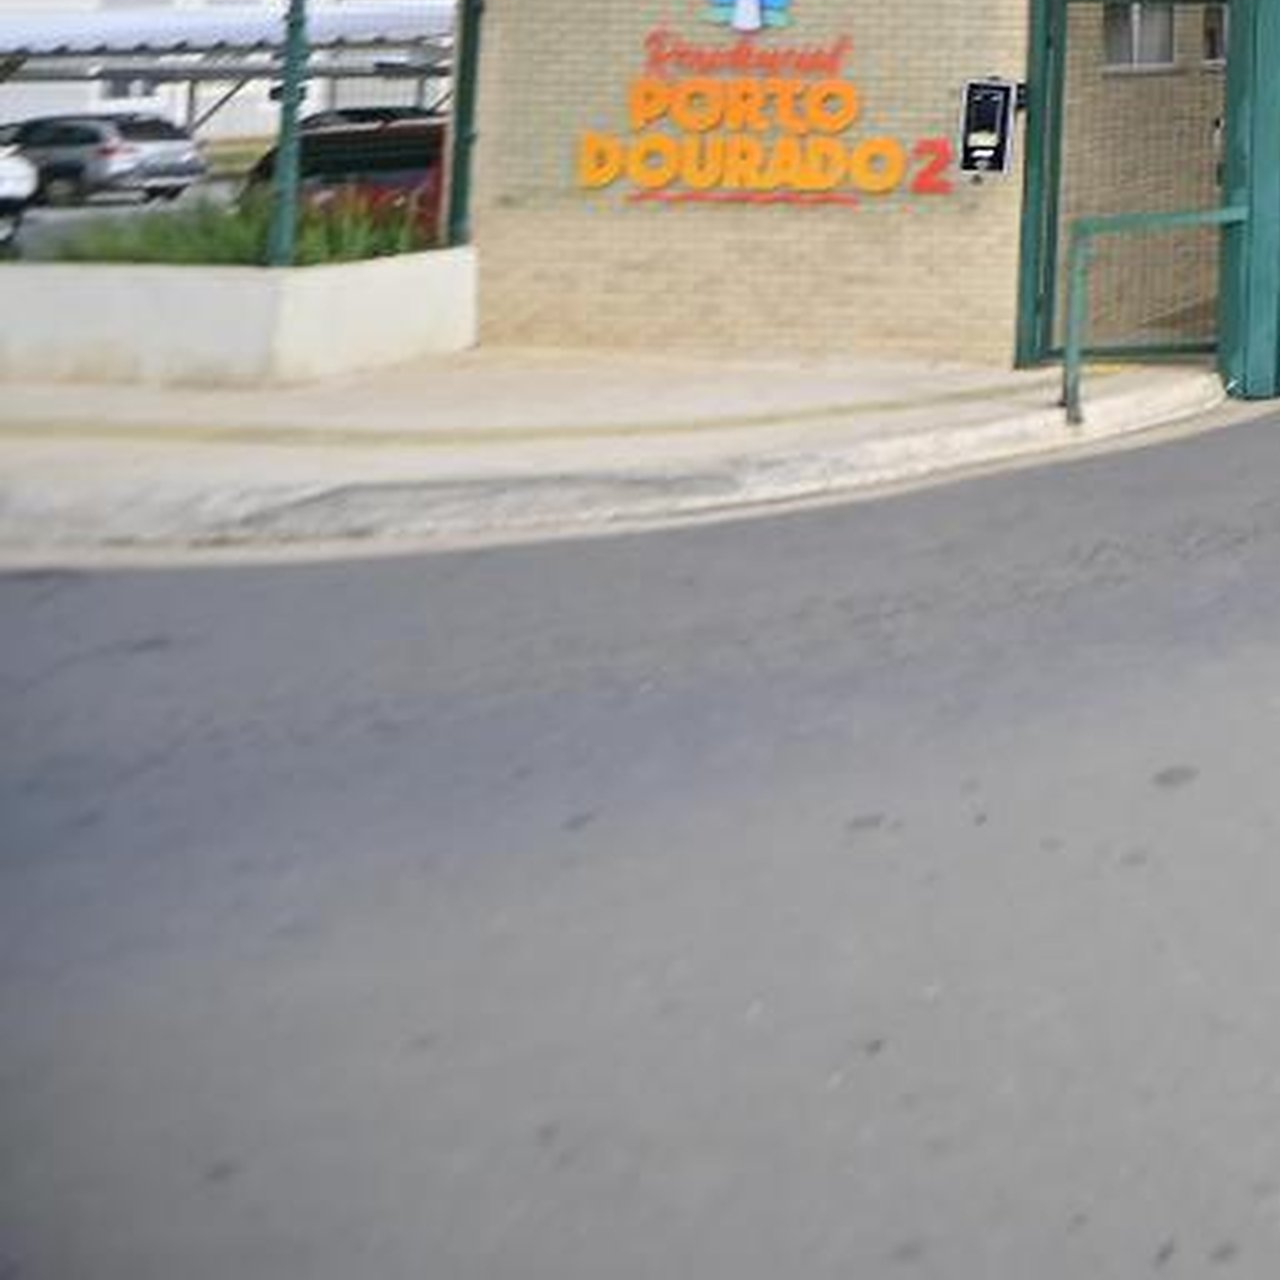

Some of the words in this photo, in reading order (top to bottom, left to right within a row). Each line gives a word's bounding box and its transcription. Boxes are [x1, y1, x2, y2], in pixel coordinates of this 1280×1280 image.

[629, 76, 858, 133] PORTO
[577, 130, 907, 193] DOURADO
[910, 138, 954, 195] 2
